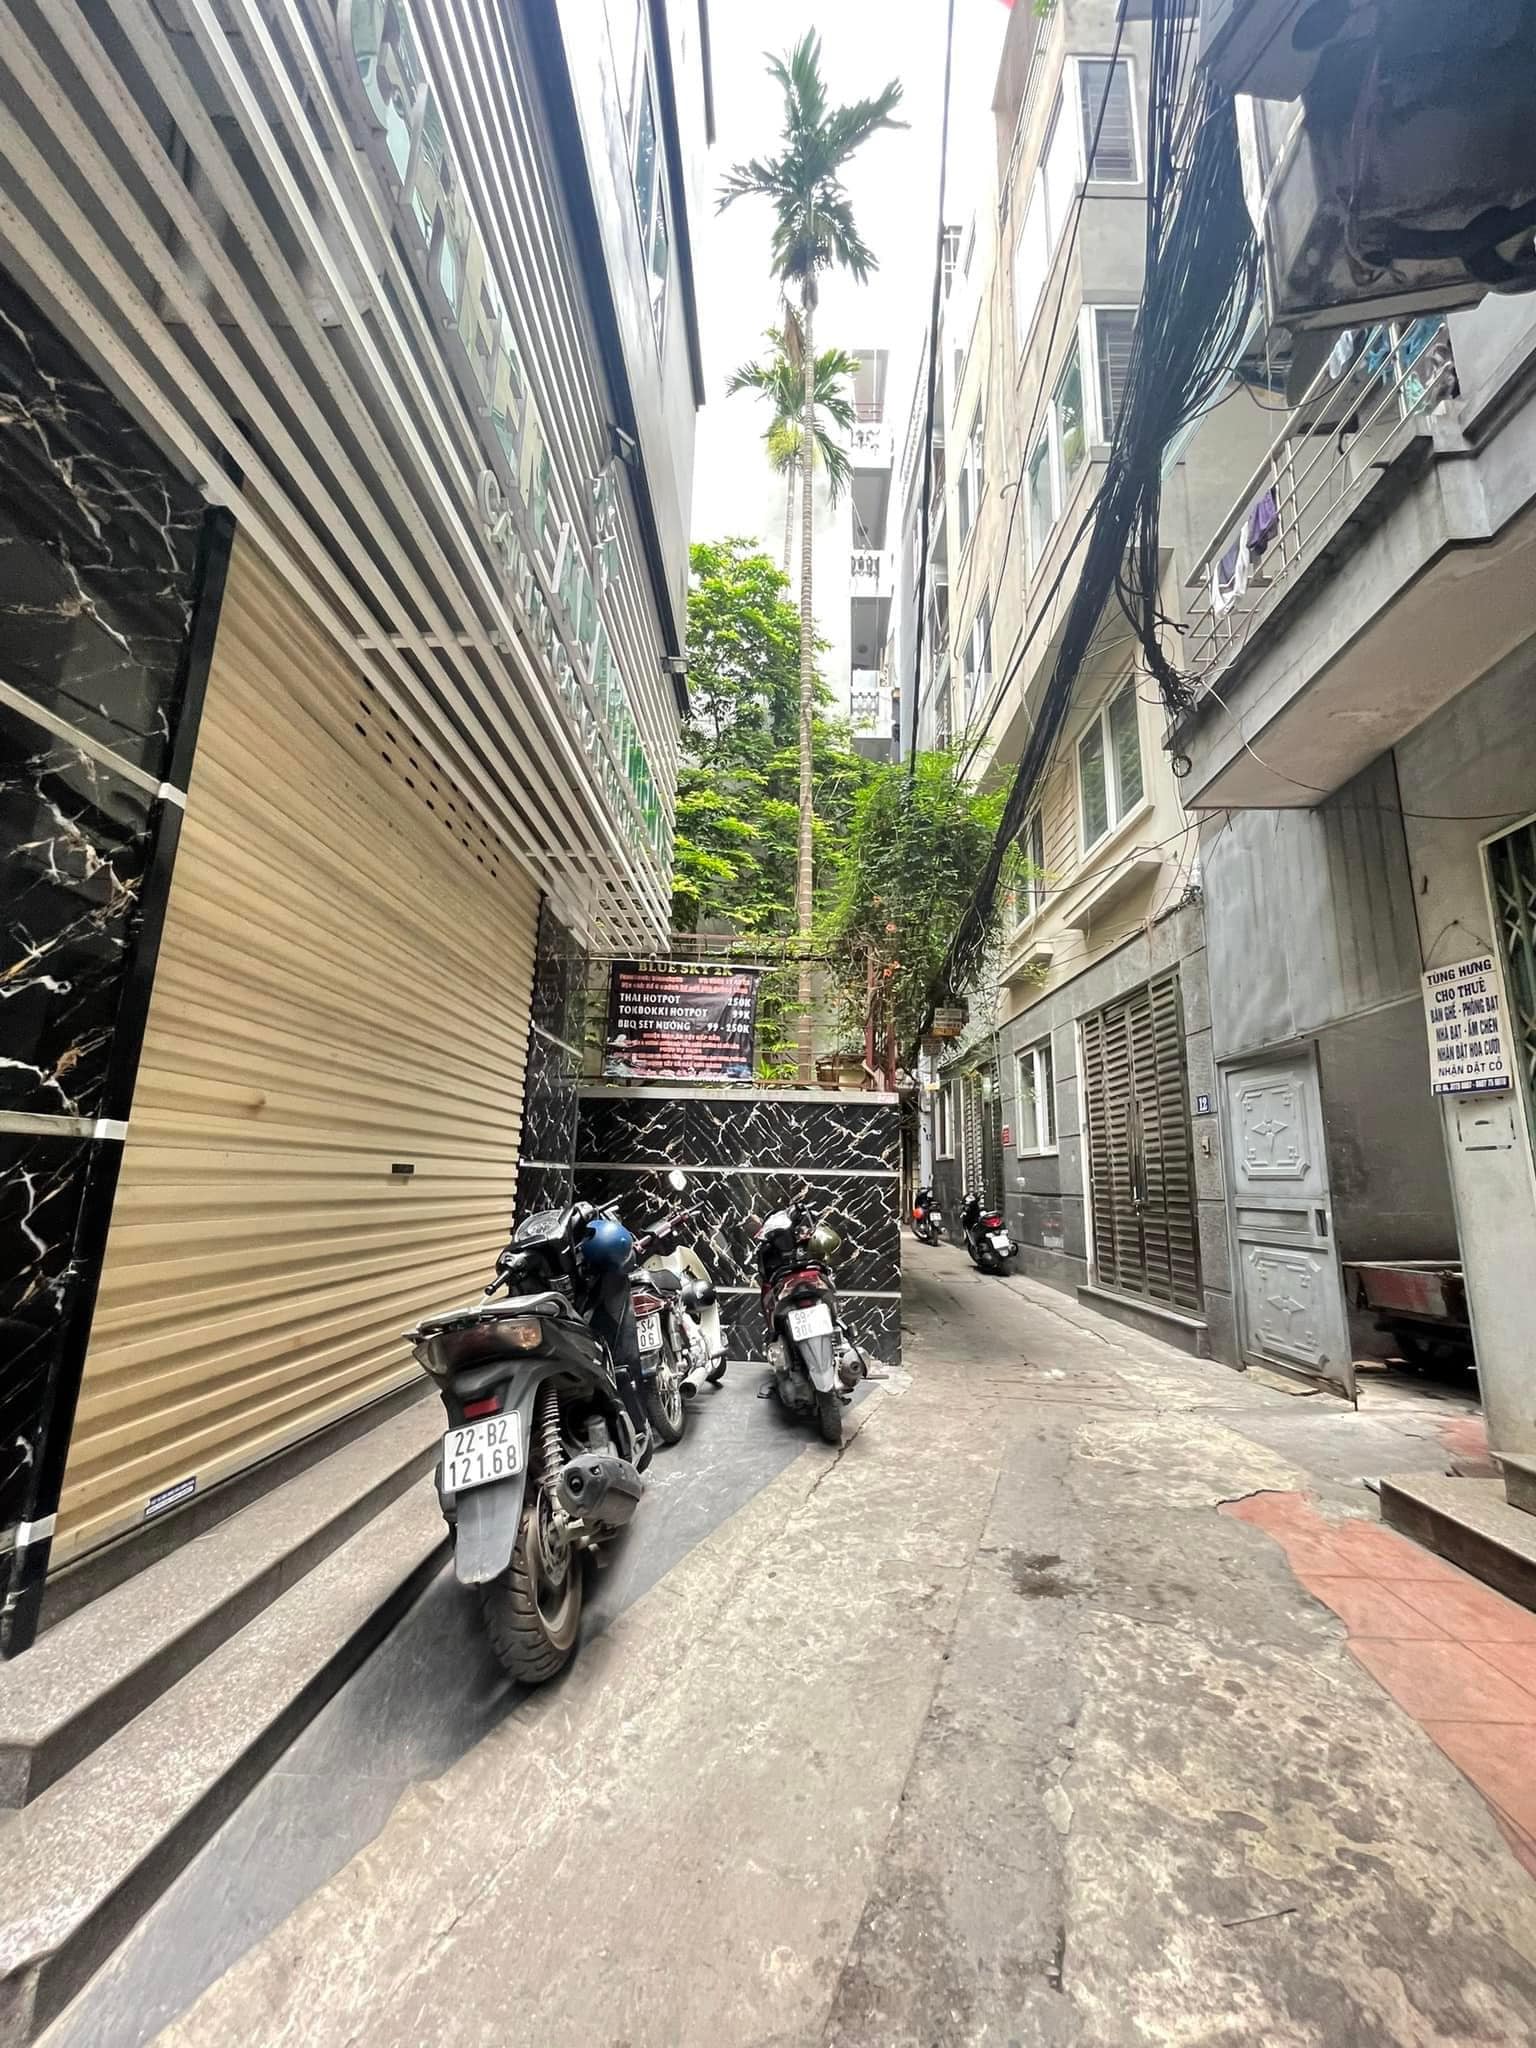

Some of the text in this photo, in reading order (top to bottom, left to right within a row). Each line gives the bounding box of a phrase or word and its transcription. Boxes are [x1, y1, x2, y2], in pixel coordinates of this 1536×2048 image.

[638, 961, 677, 973] BLUE
[1427, 959, 1492, 986] TÙNG HƯNG
[620, 993, 641, 1002] THAI
[643, 994, 681, 1005] HOTPOT
[1435, 977, 1487, 1003] CHO THUÊ
[670, 1007, 708, 1017] HOTPOT
[732, 1010, 751, 1020] 99K
[618, 1019, 637, 1030] BBQ
[639, 1020, 655, 1029] SET
[707, 1023, 719, 1032] 99
[455, 1419, 508, 1457] 22-B2
[449, 1444, 517, 1487] 121.68
